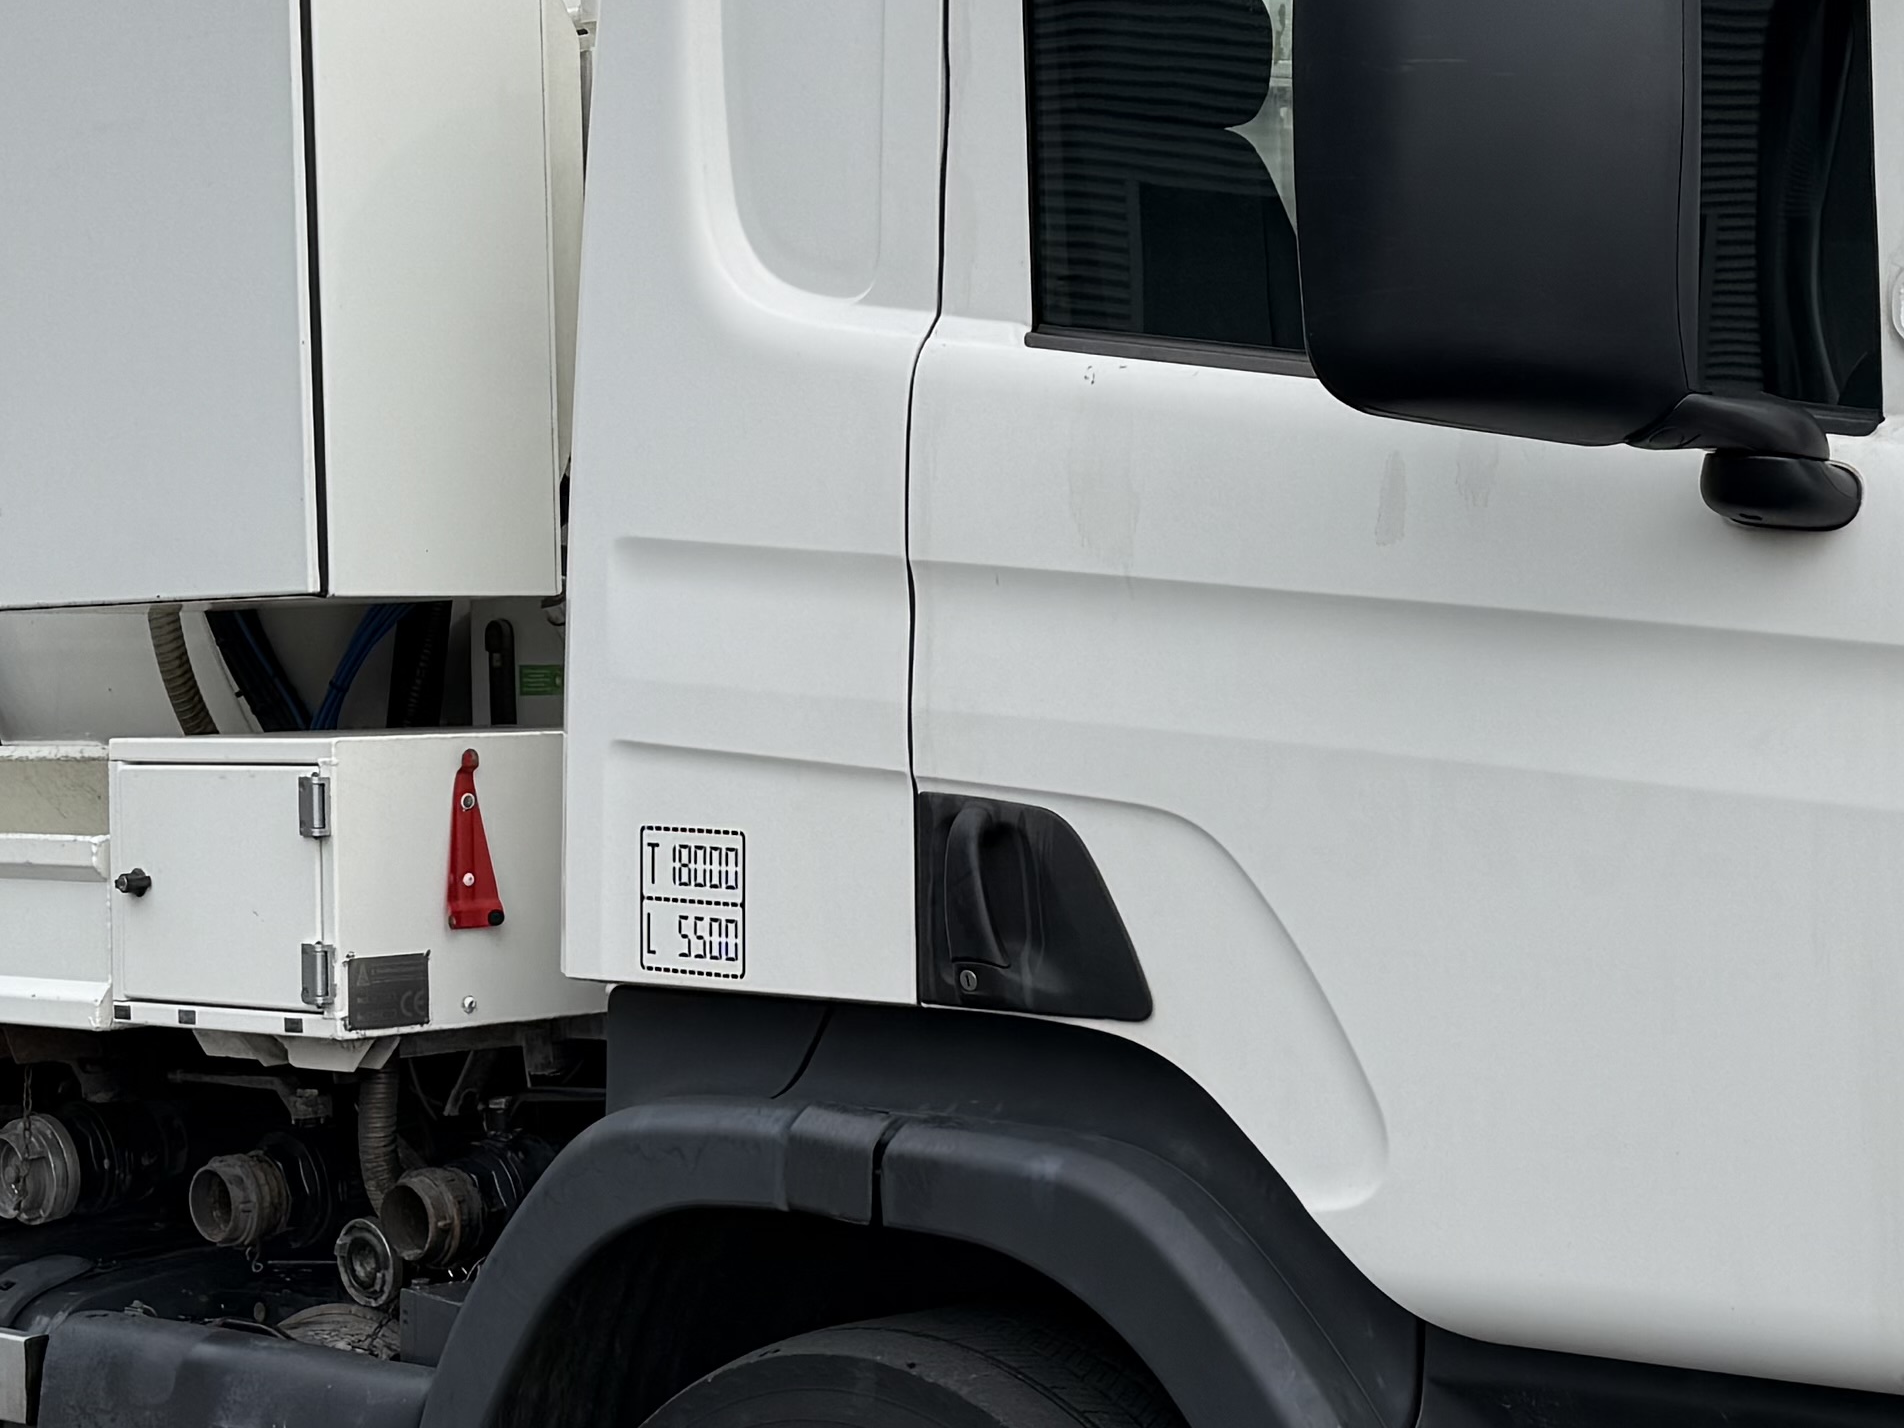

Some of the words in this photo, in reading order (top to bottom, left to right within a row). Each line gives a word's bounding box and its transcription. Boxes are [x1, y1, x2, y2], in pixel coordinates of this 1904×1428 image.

[647, 842, 660, 885] T
[673, 844, 739, 890] 18000
[647, 912, 657, 955] L
[678, 914, 739, 962] 5500
